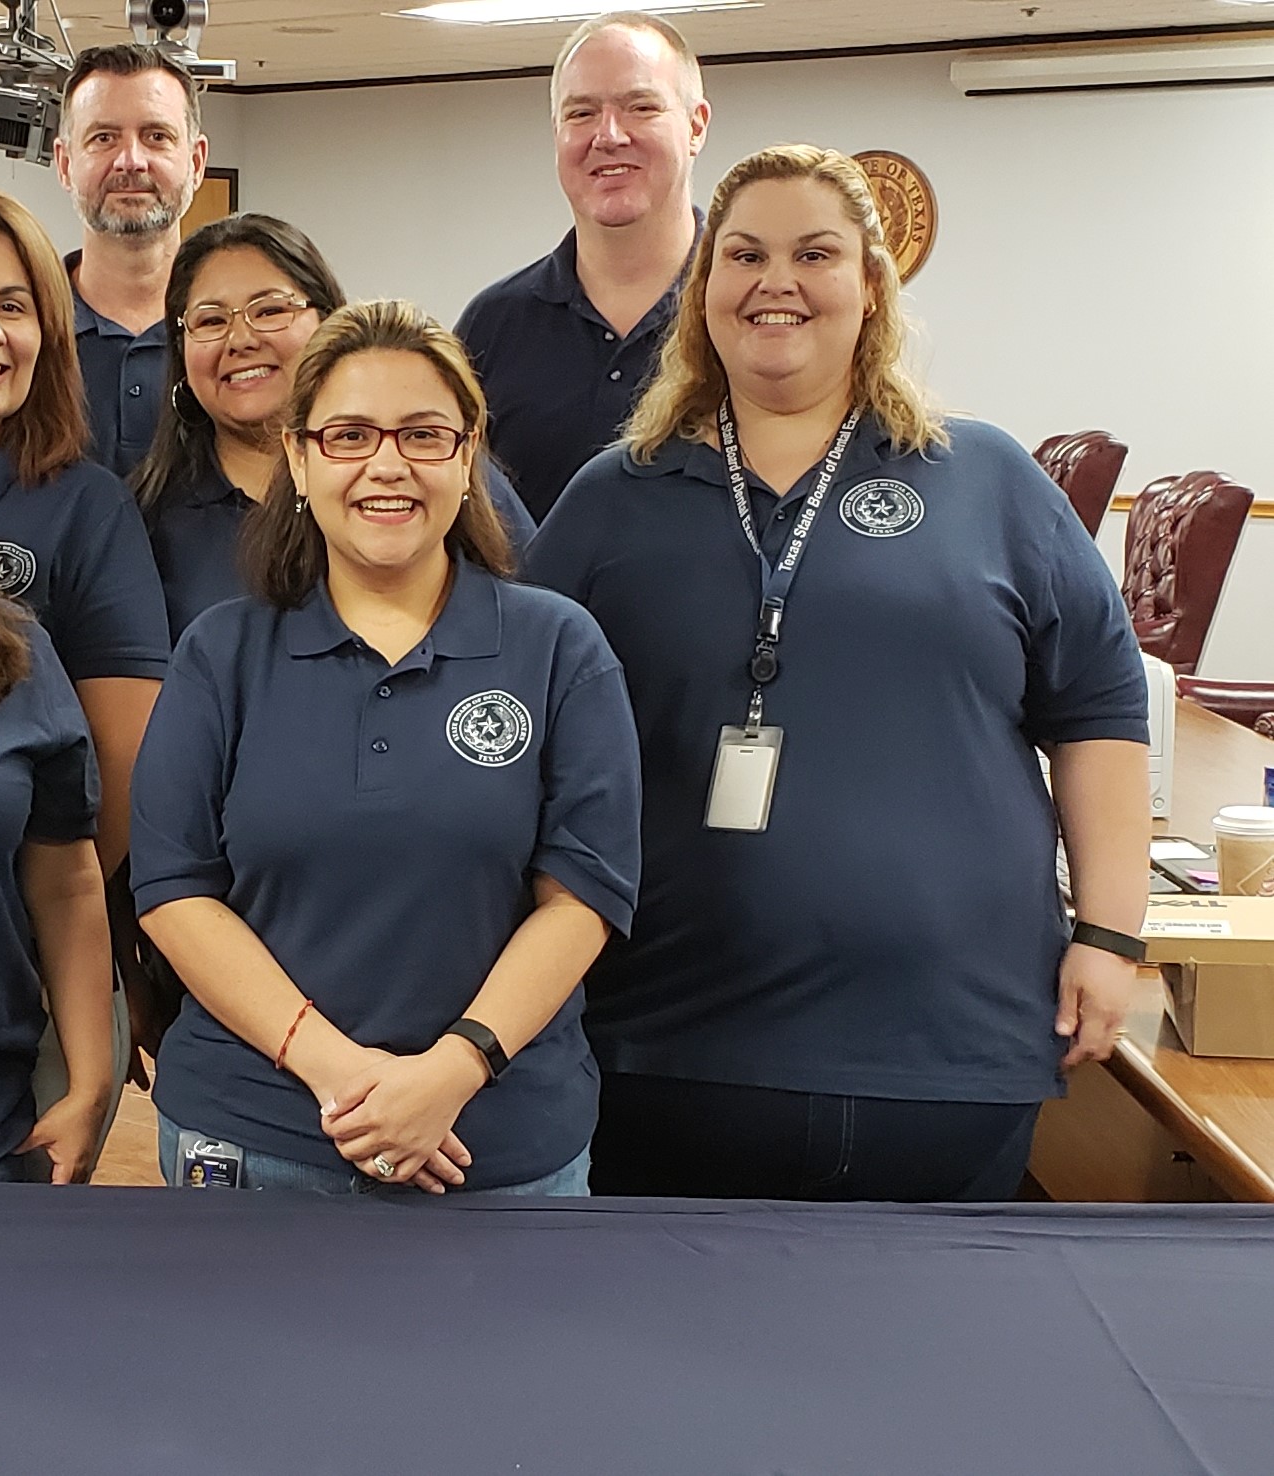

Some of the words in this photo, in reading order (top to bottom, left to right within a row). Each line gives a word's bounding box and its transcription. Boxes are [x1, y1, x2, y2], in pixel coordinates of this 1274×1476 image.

[907, 181, 926, 245] TEXAS
[721, 421, 735, 446] State
[827, 430, 852, 460] Dental
[725, 444, 742, 472] Board
[825, 458, 838, 473] of
[730, 472, 744, 484] of
[807, 471, 832, 508] Board
[732, 481, 749, 518] Dental
[793, 508, 816, 539] State
[777, 539, 803, 572] Texas
[477, 753, 506, 762] TEXAS
